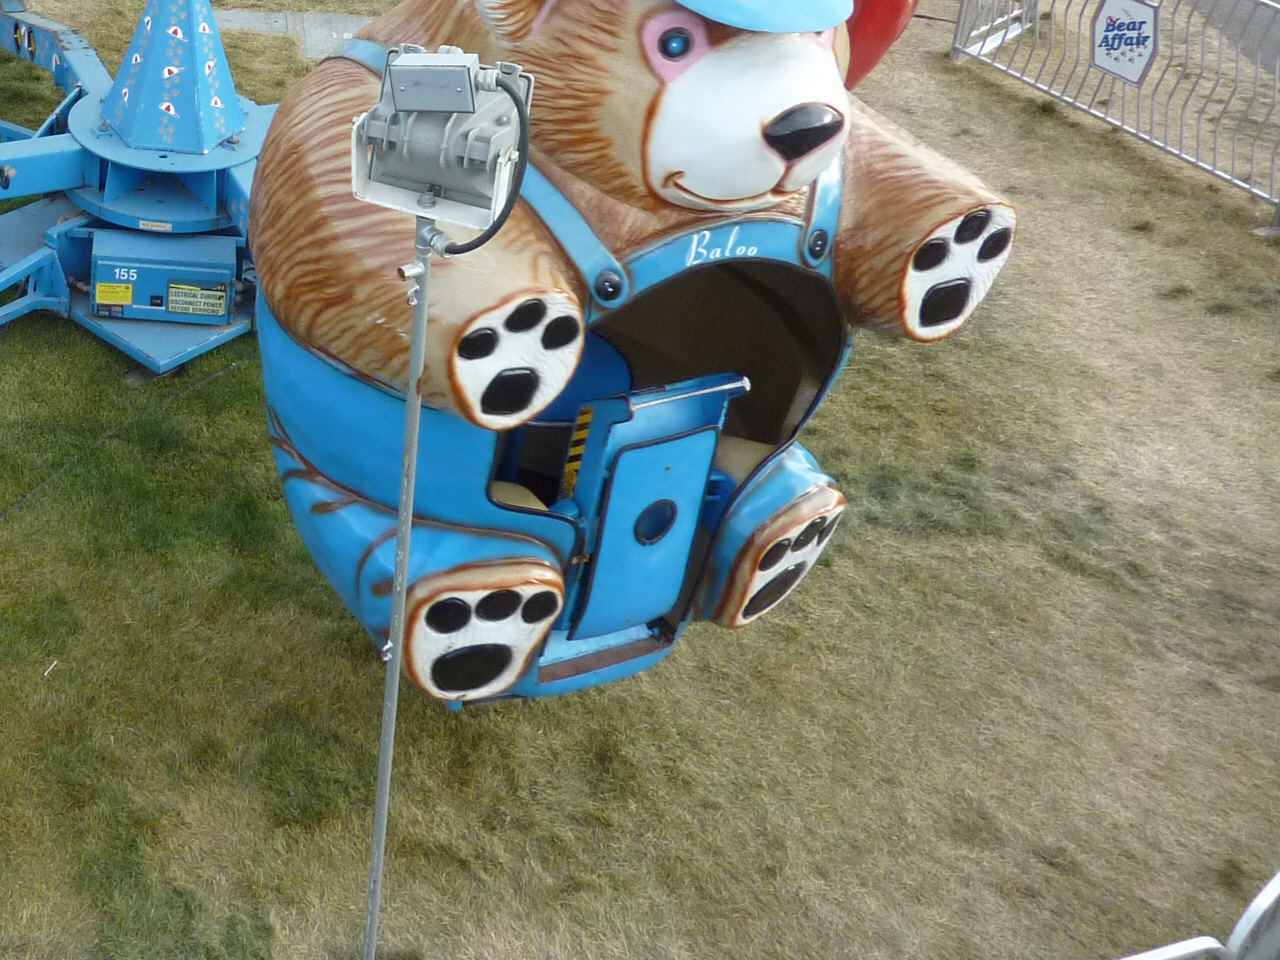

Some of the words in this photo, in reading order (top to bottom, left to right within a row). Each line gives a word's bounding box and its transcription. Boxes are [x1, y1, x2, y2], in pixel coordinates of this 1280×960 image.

[1103, 18, 1147, 33] Bear
[1097, 32, 1150, 51] Affair
[686, 226, 758, 267] Baloo
[114, 268, 138, 281] 155
